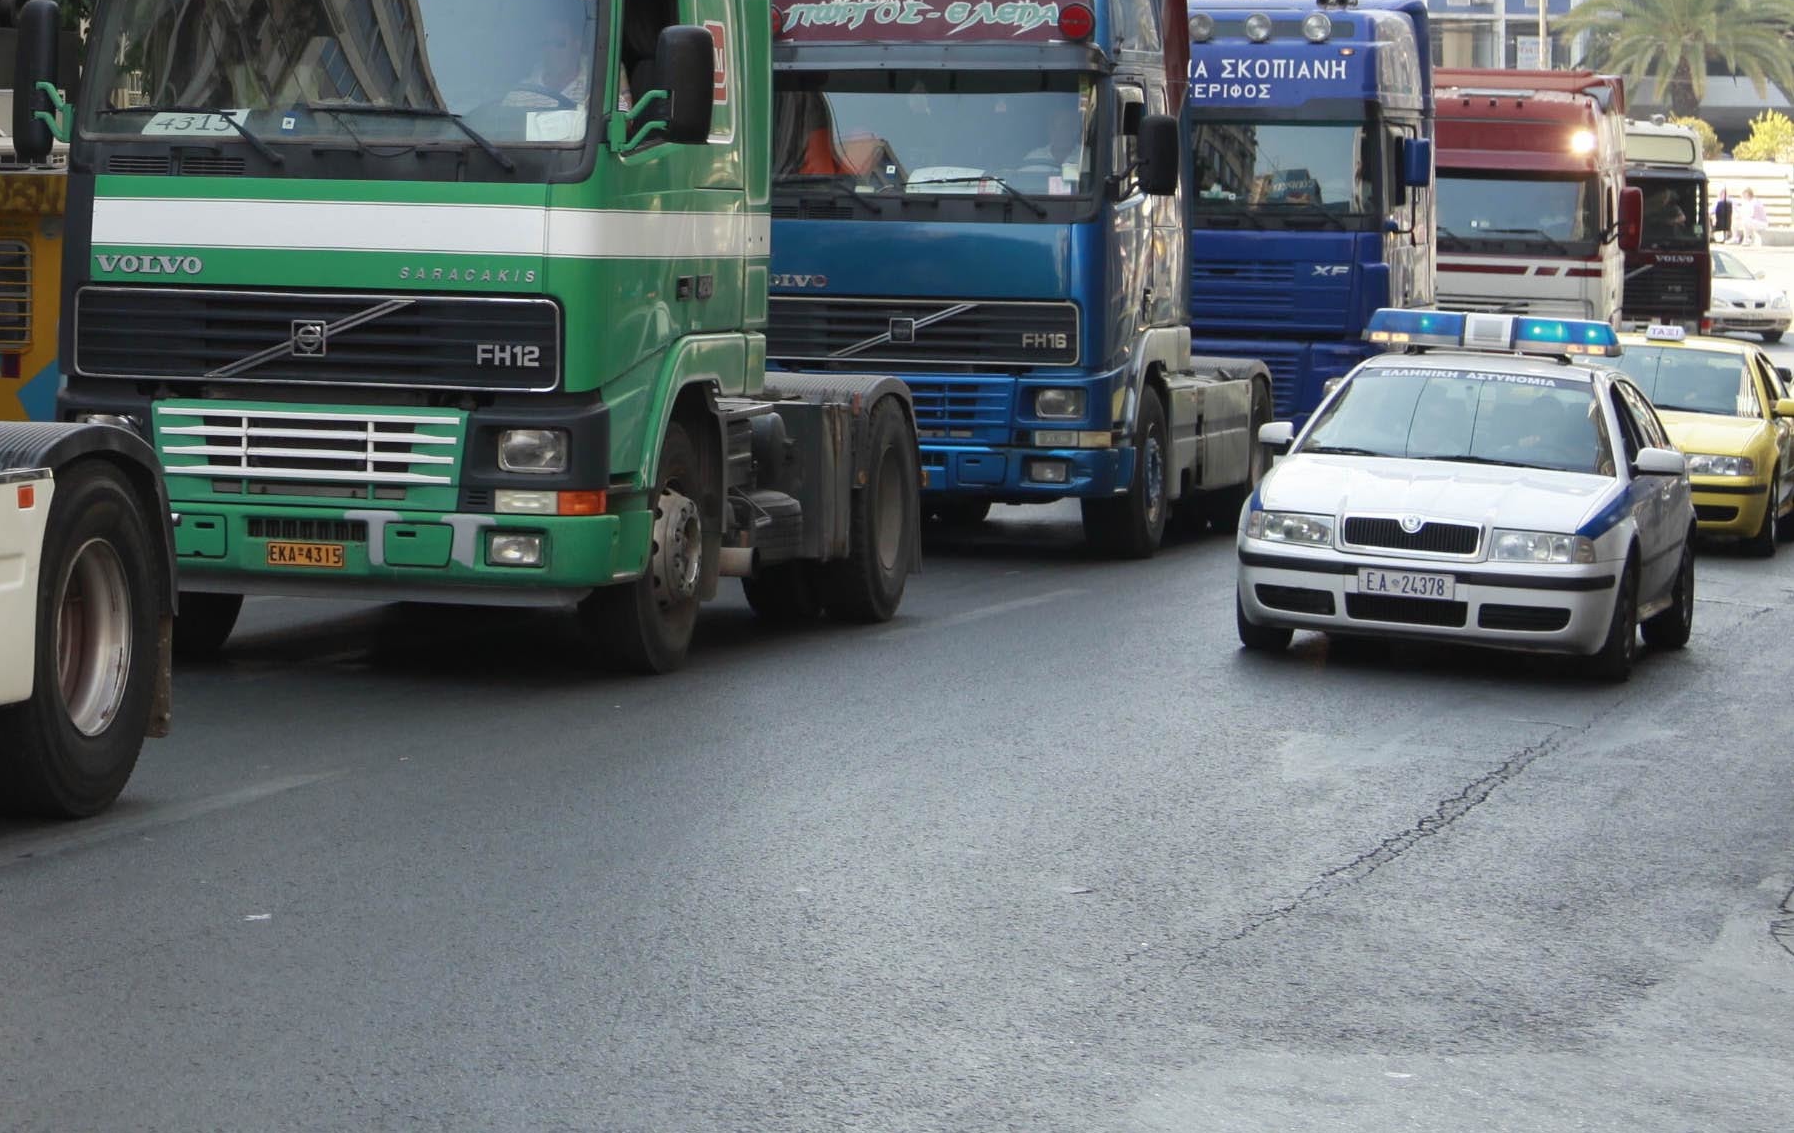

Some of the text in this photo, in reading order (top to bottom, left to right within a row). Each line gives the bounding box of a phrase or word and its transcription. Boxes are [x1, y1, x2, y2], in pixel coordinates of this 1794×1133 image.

[1221, 59, 1347, 80] ΣΚΟΠΙΑΝΗ
[1189, 83, 1271, 99] ΕΡΙΦΟΣ
[156, 115, 230, 132] 4315
[95, 254, 203, 275] VOLVO
[1655, 254, 1694, 263] VOLVO
[398, 266, 536, 283] SARACAKIS
[1310, 265, 1349, 276] XF
[1022, 332, 1067, 349] FH16
[476, 343, 540, 367] FH12
[1381, 369, 1556, 387] ΕΛΛΗΝΙΚΗ ΑΣΤΥΝΟΜΙΑ
[1401, 575, 1445, 596] 24378
